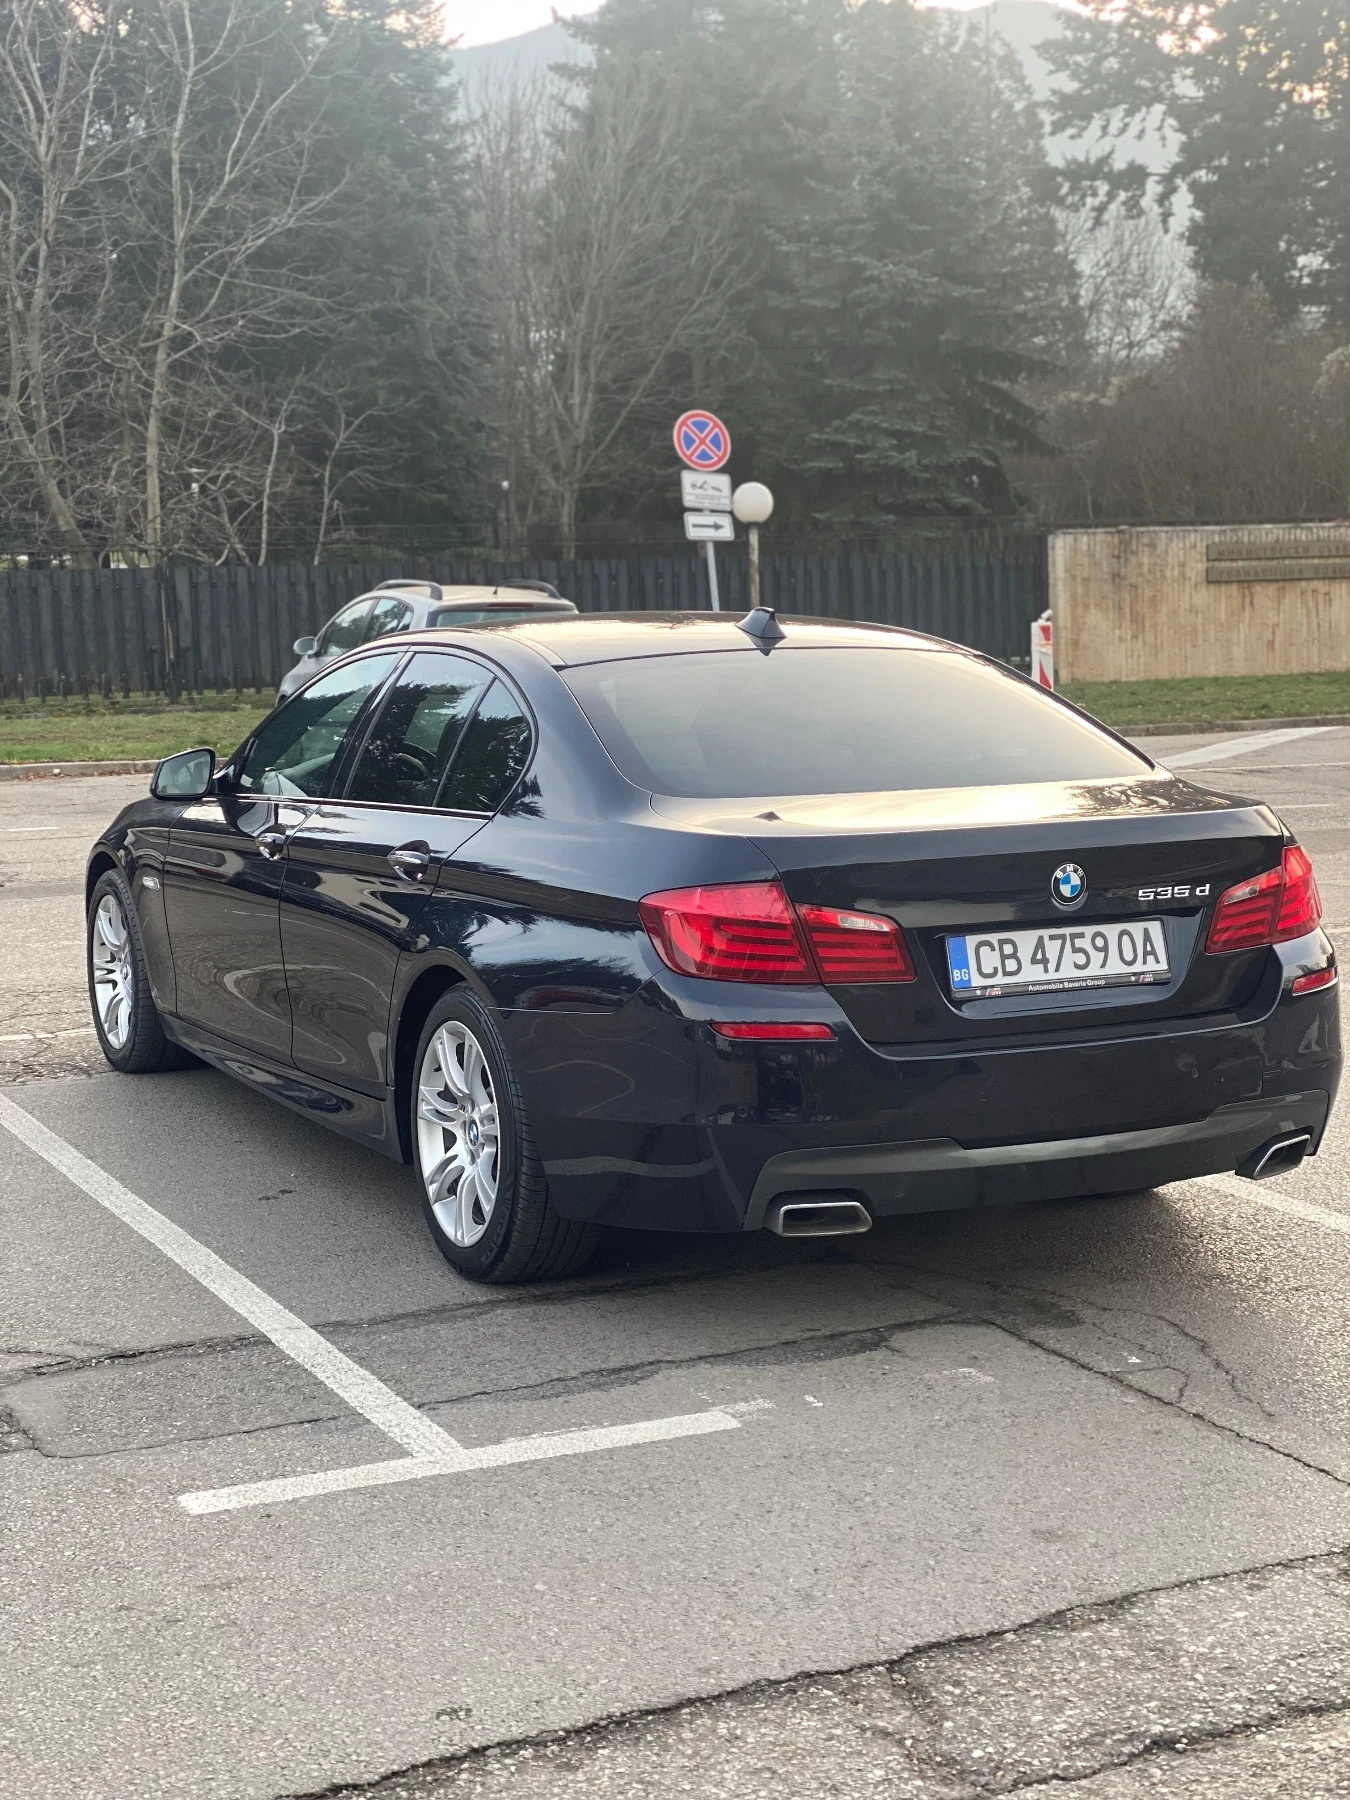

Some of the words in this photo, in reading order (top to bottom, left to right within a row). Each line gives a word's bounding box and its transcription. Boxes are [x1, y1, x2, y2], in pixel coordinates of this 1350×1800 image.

[1055, 865, 1085, 879] BMW
[1138, 885, 1191, 901] 535
[1195, 883, 1211, 896] d
[974, 937, 1023, 979] CB
[1030, 930, 1110, 974] 4759
[953, 968, 969, 981] BG
[1028, 983, 1063, 992] Automobile
[1063, 980, 1087, 989] Bavaria
